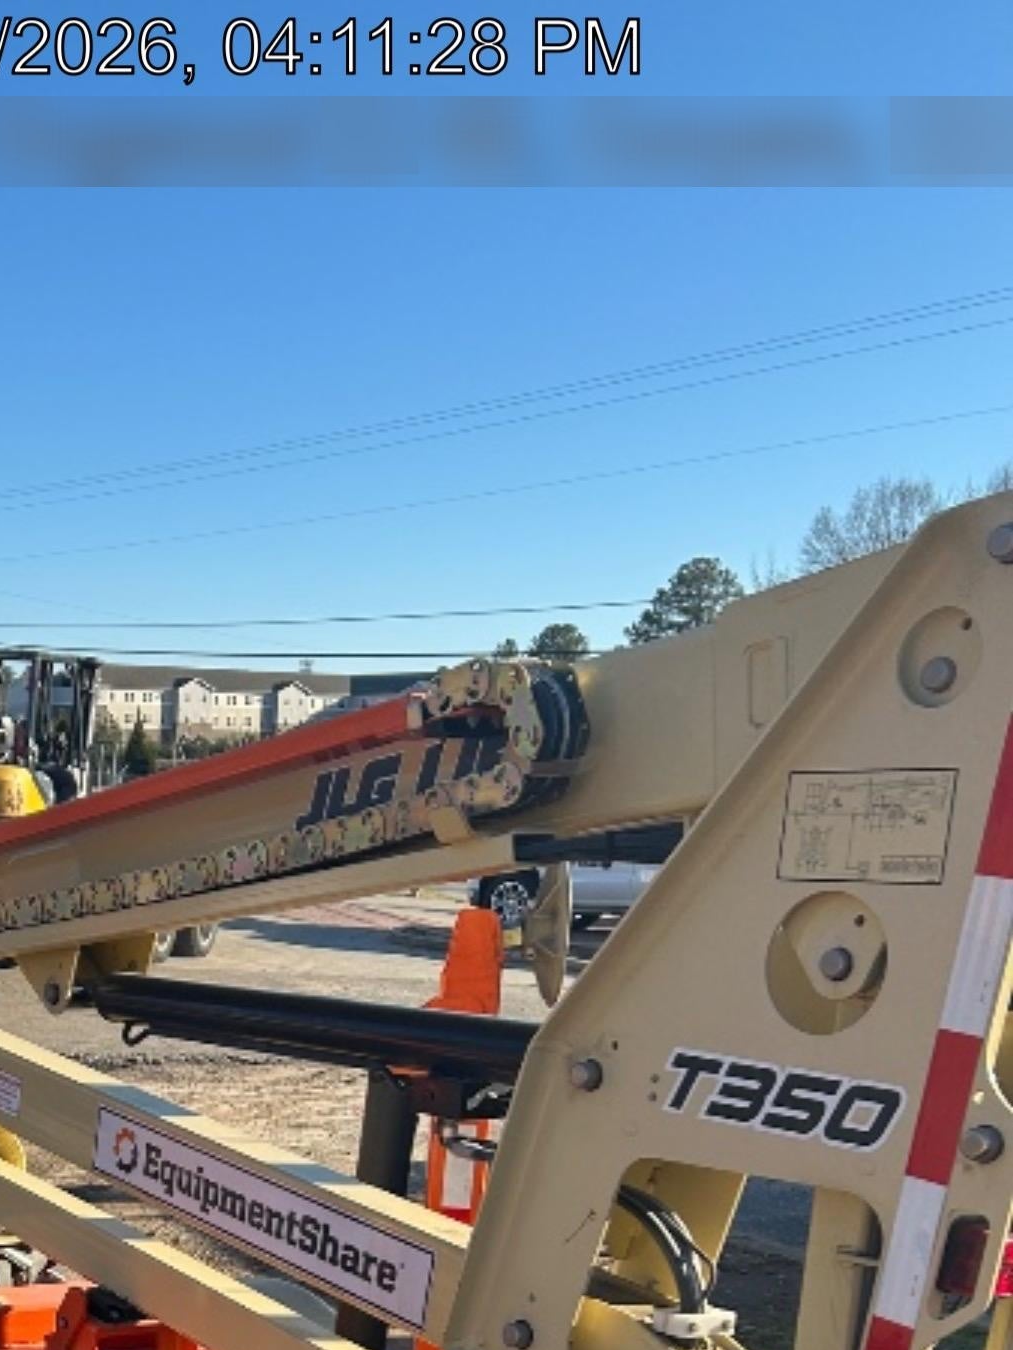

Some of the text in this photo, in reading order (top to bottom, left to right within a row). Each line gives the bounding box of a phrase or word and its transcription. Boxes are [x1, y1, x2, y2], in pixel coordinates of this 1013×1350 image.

[296, 752, 402, 833] JLG
[667, 1051, 903, 1148] T350
[142, 1142, 398, 1293] EquipmentShare
